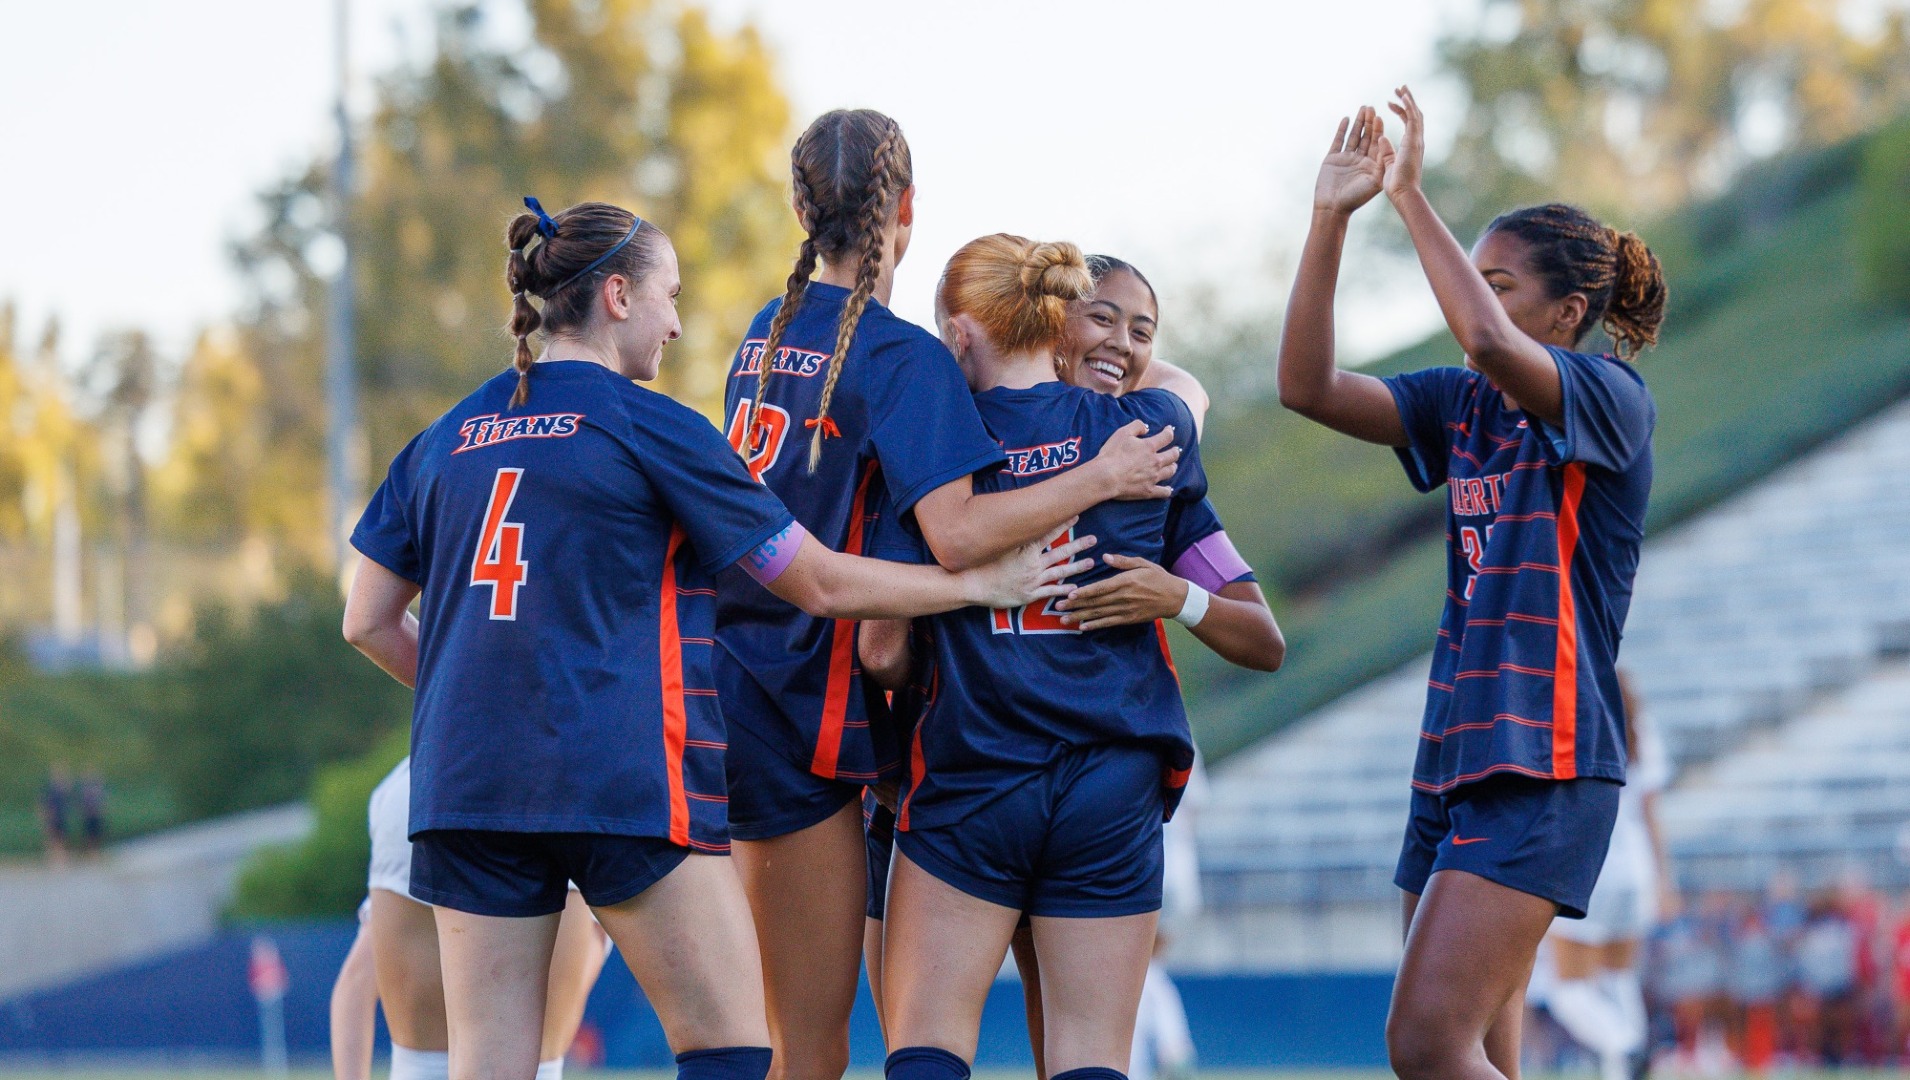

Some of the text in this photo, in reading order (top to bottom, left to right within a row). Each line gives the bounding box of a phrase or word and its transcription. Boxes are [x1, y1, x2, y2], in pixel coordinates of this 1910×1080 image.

[736, 339, 830, 377] TIANS
[453, 413, 585, 453] TITANS
[1003, 437, 1082, 476] TANS
[470, 467, 528, 621] 4
